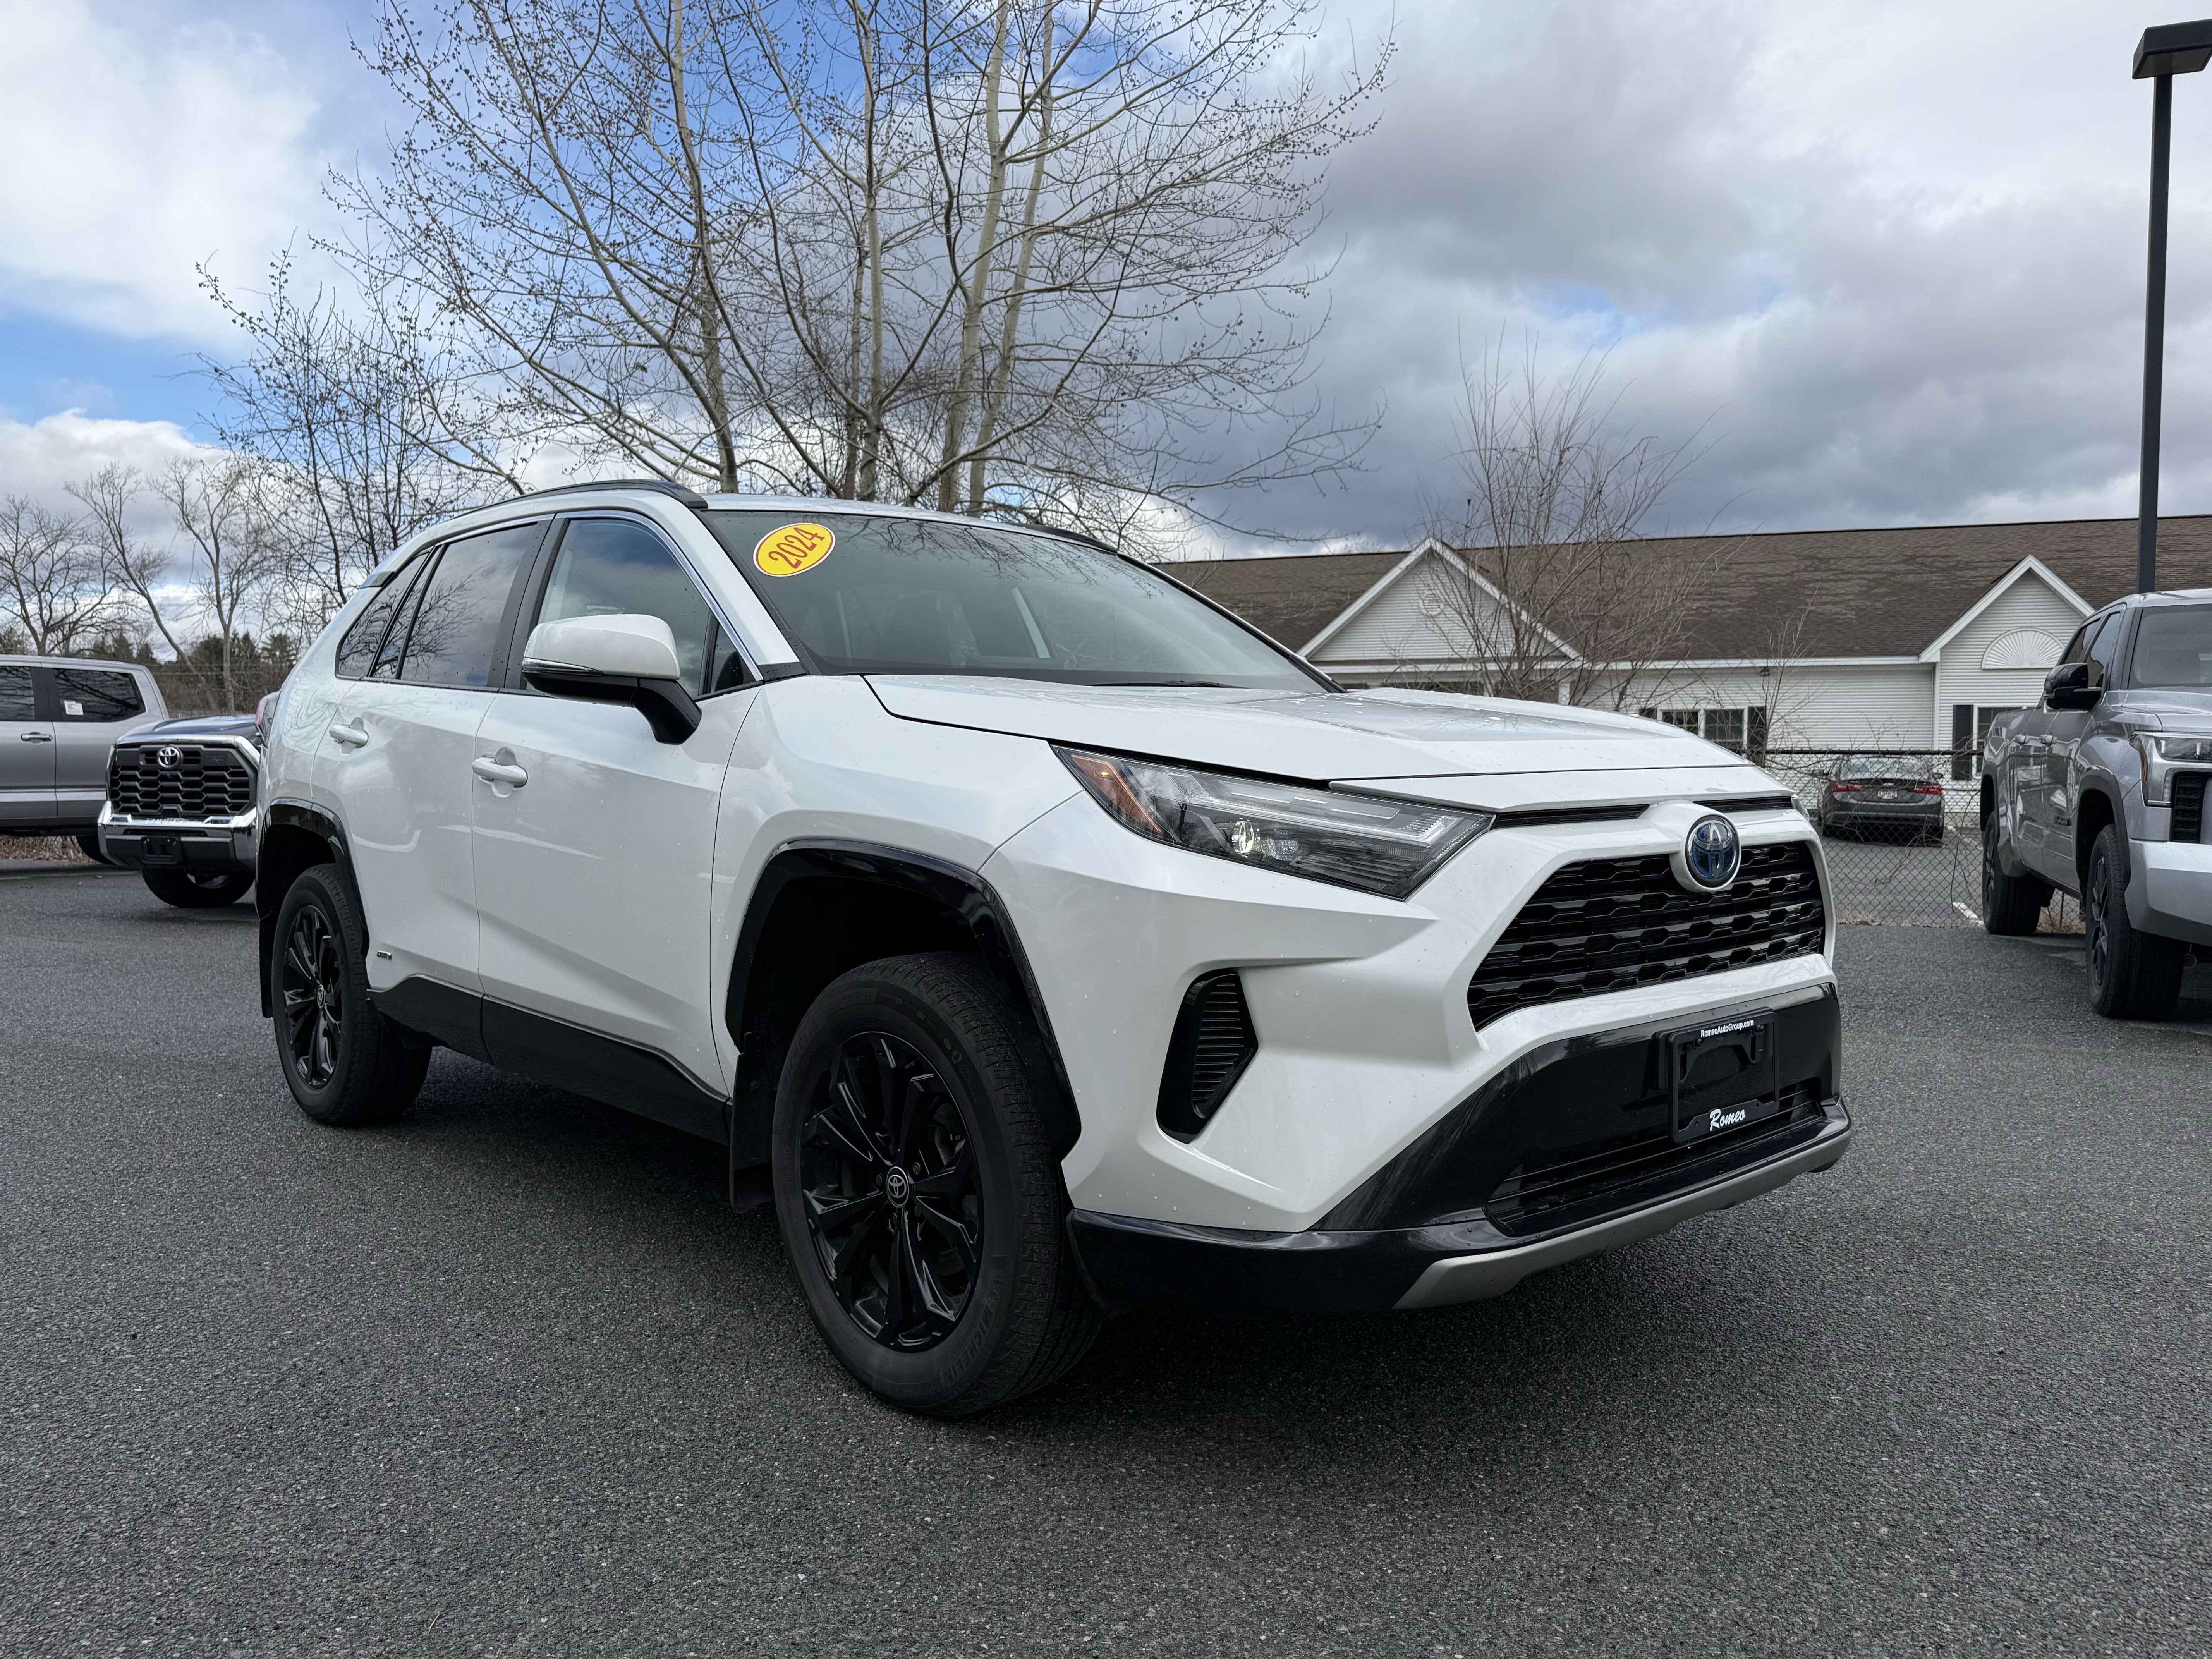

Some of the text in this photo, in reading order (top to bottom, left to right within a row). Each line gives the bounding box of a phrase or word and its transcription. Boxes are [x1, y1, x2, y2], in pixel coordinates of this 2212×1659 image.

[768, 527, 825, 569] 2024
[1700, 1020, 1754, 1038] RomeoAutoGroup.com
[1709, 1108, 1746, 1132] Romeo
